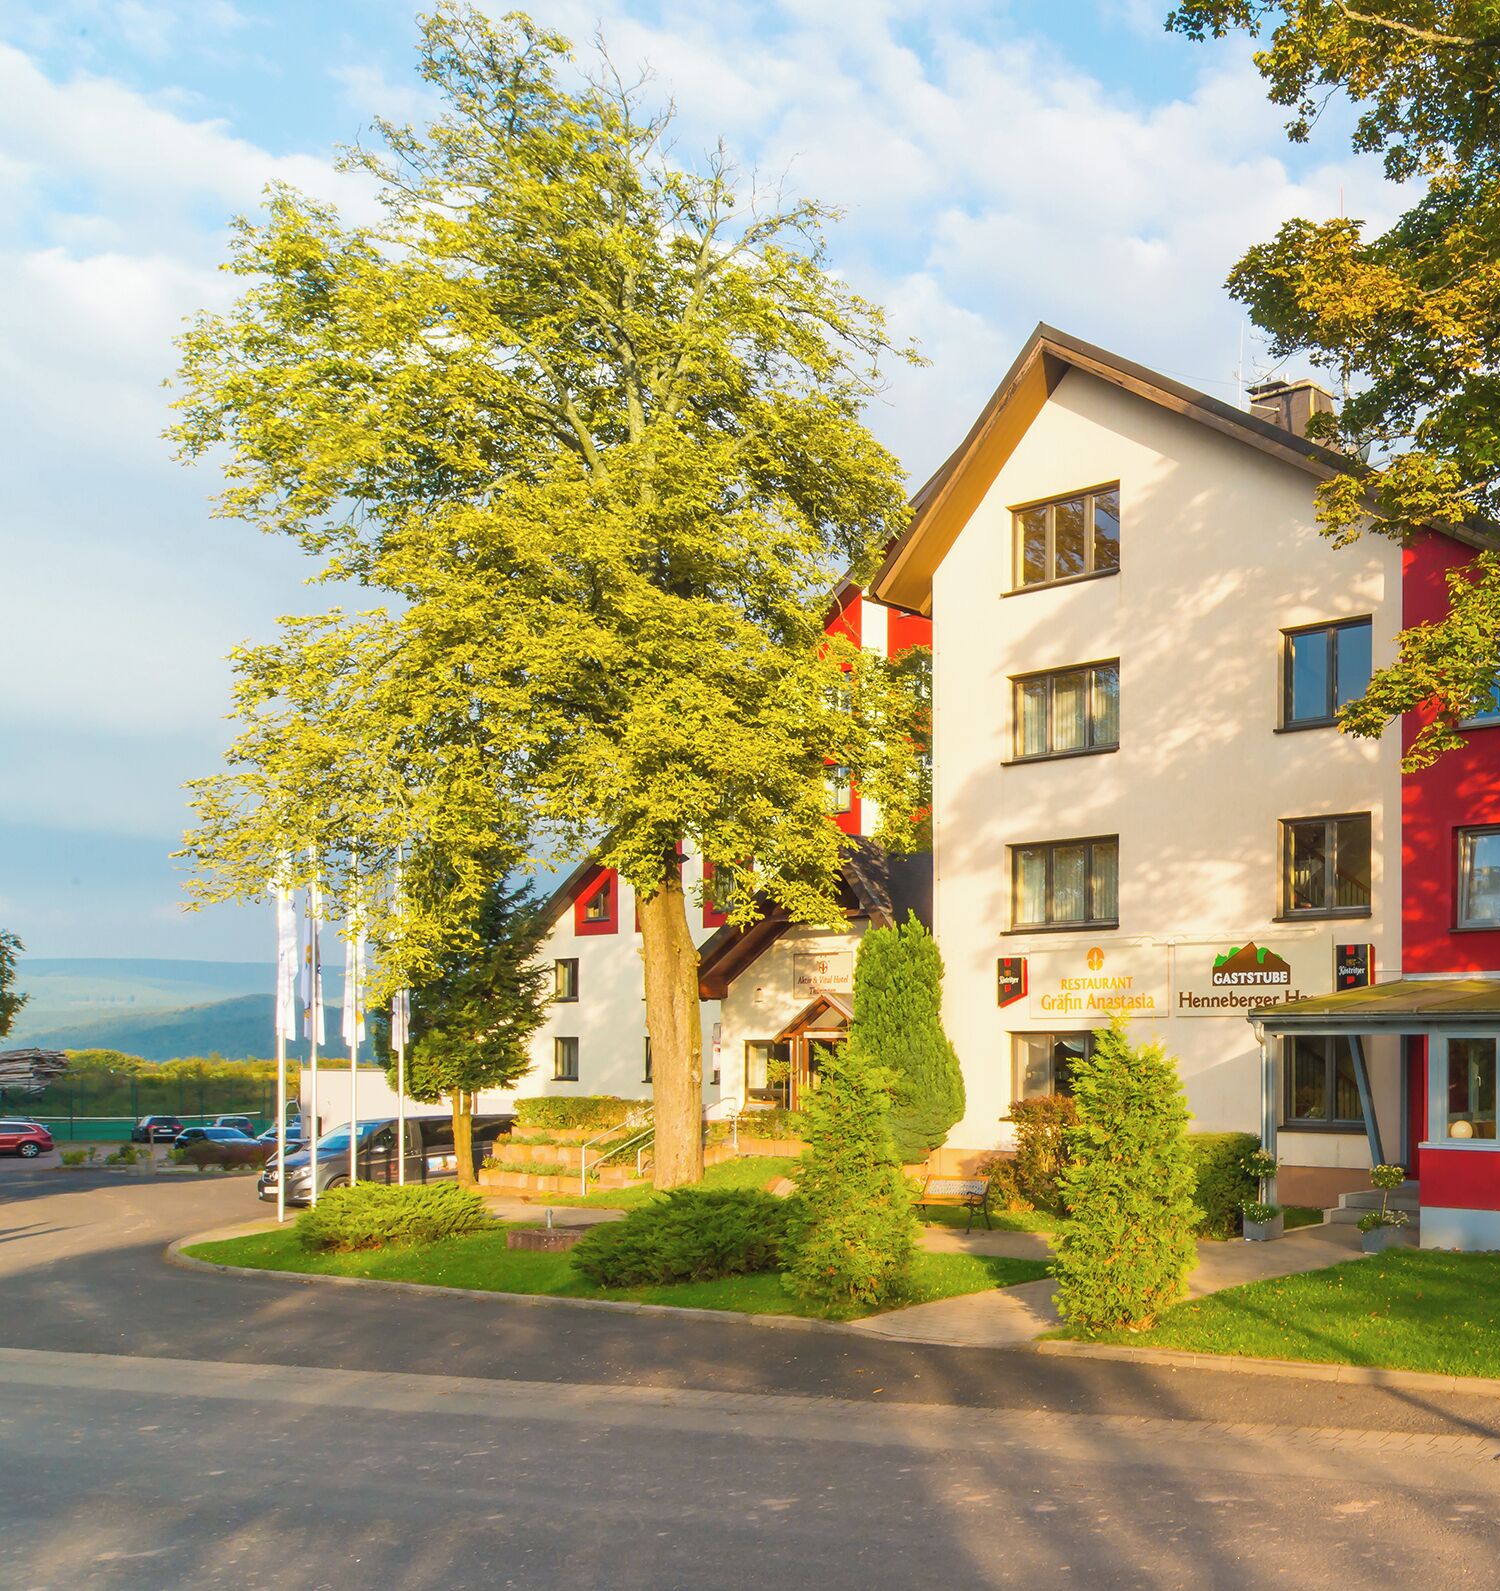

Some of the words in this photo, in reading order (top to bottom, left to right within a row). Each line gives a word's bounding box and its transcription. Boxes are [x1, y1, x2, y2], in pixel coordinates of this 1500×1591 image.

[1061, 976, 1134, 990] RESTAURANT
[1213, 971, 1288, 985] GASTSTUBE
[1041, 992, 1082, 1014] Gräfin
[1086, 992, 1155, 1009] Anastasia
[1178, 991, 1280, 1008] Henneberger
